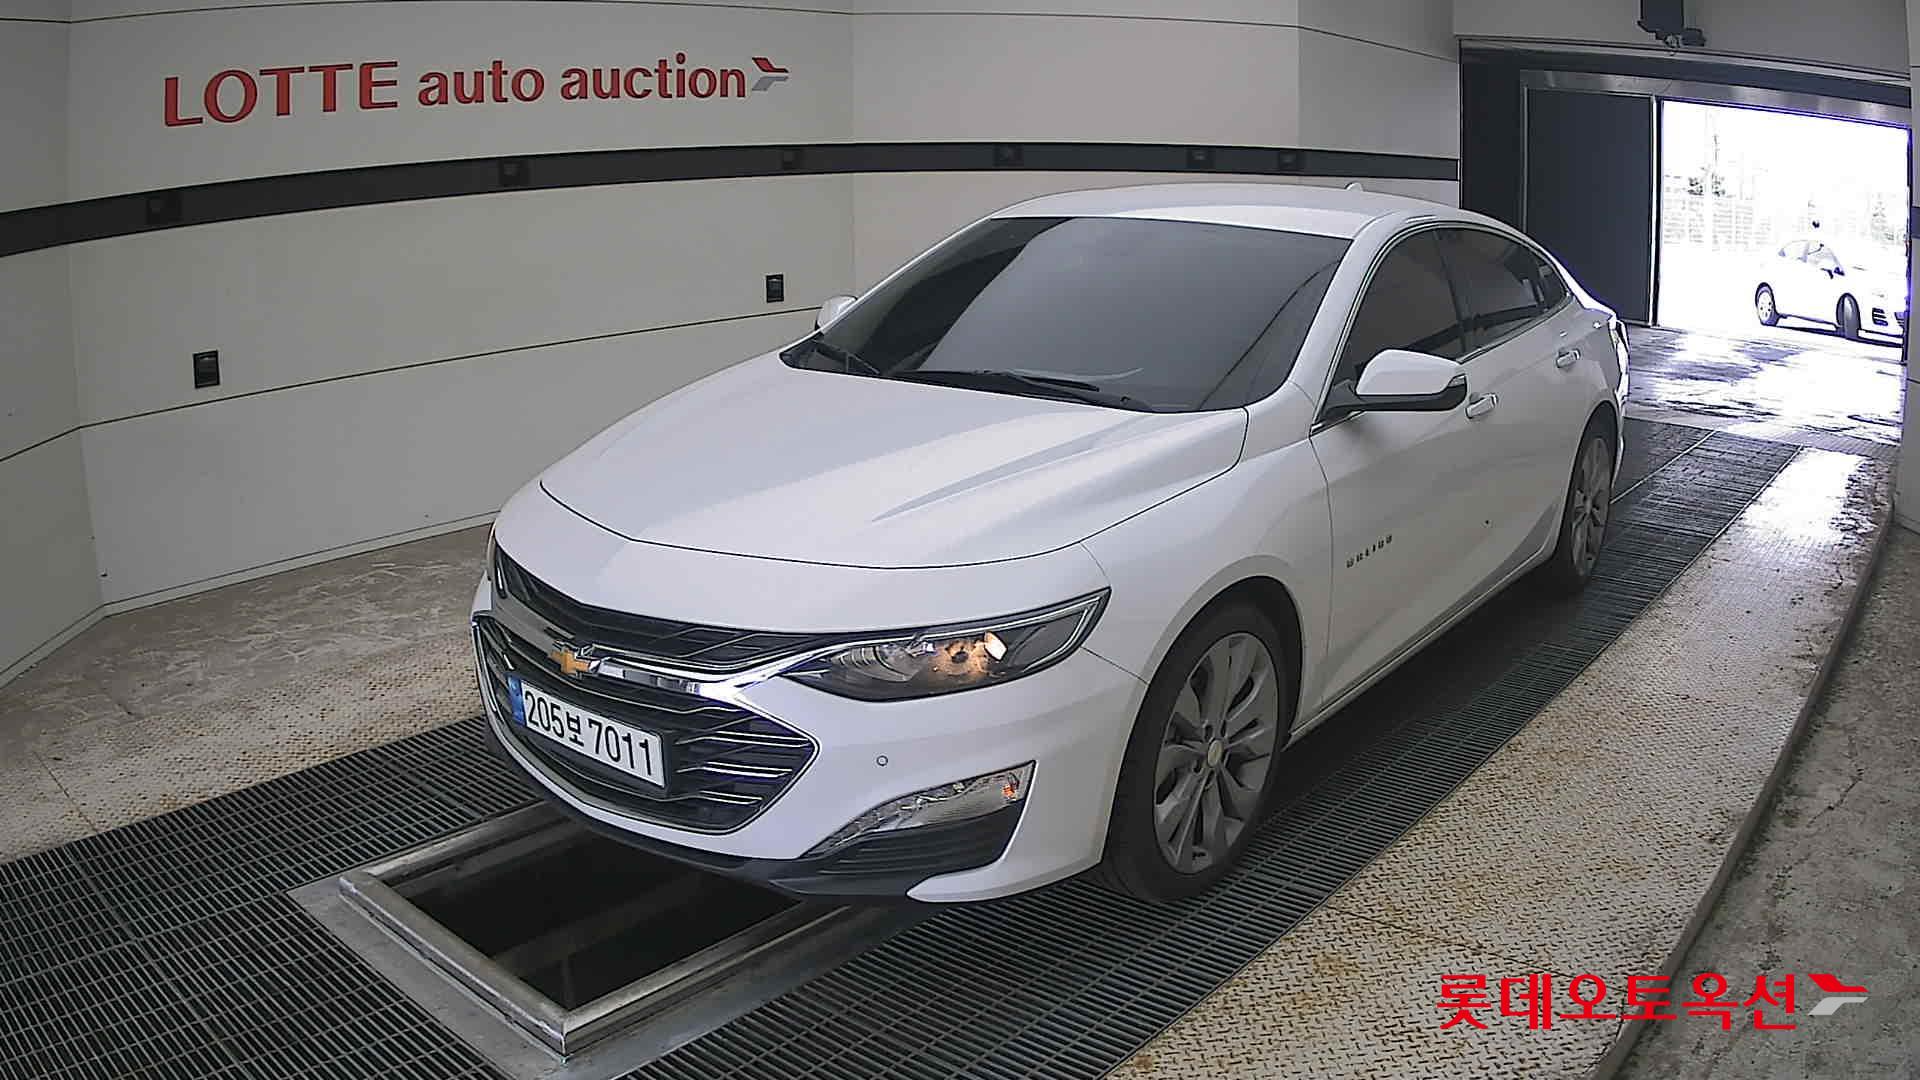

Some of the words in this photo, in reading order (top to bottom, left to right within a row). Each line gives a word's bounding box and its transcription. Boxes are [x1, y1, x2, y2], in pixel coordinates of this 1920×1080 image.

[164, 61, 399, 127] LOTTE
[417, 60, 545, 106] auto
[560, 52, 746, 100] auction
